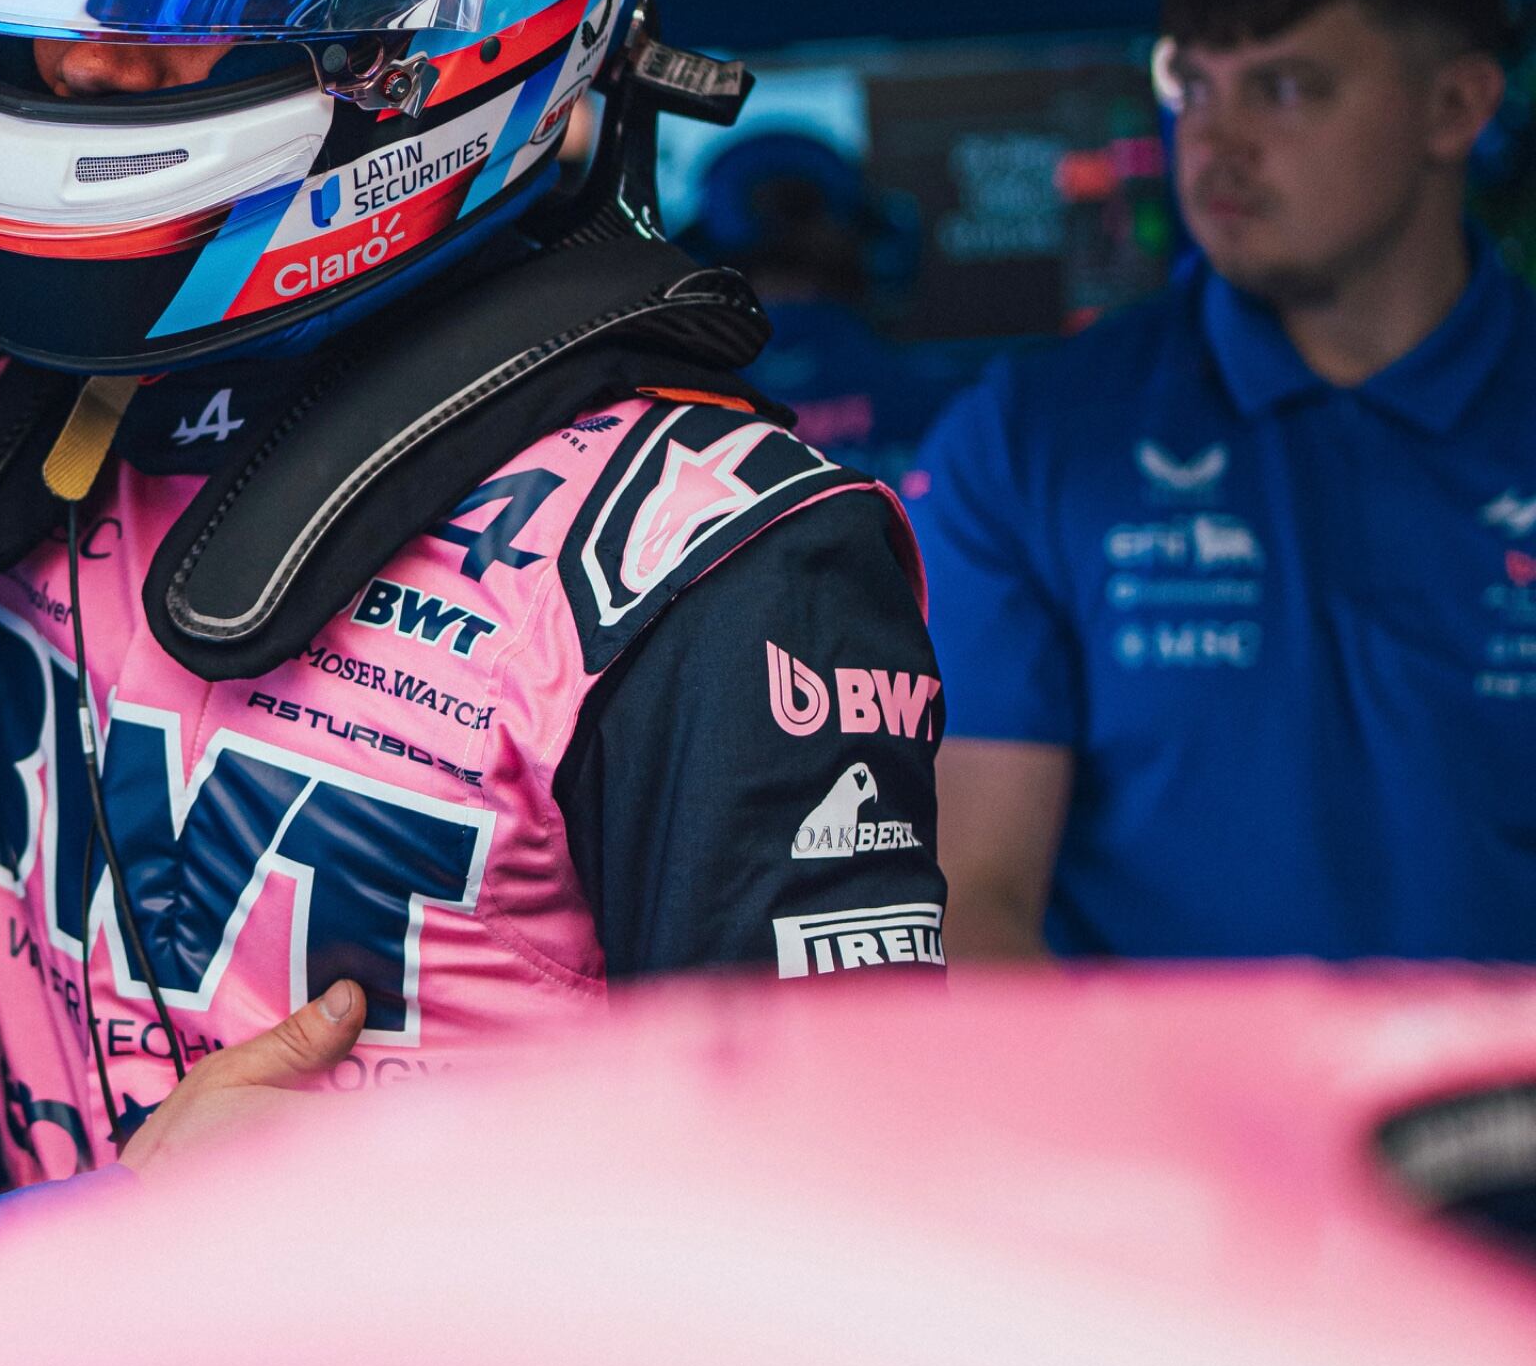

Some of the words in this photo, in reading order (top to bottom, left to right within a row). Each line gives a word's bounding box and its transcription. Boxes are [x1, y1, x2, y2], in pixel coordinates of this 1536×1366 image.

[353, 141, 423, 190] LATIN
[354, 132, 488, 216] SECURITIES
[274, 234, 389, 297] Claro
[350, 576, 500, 661] BWT
